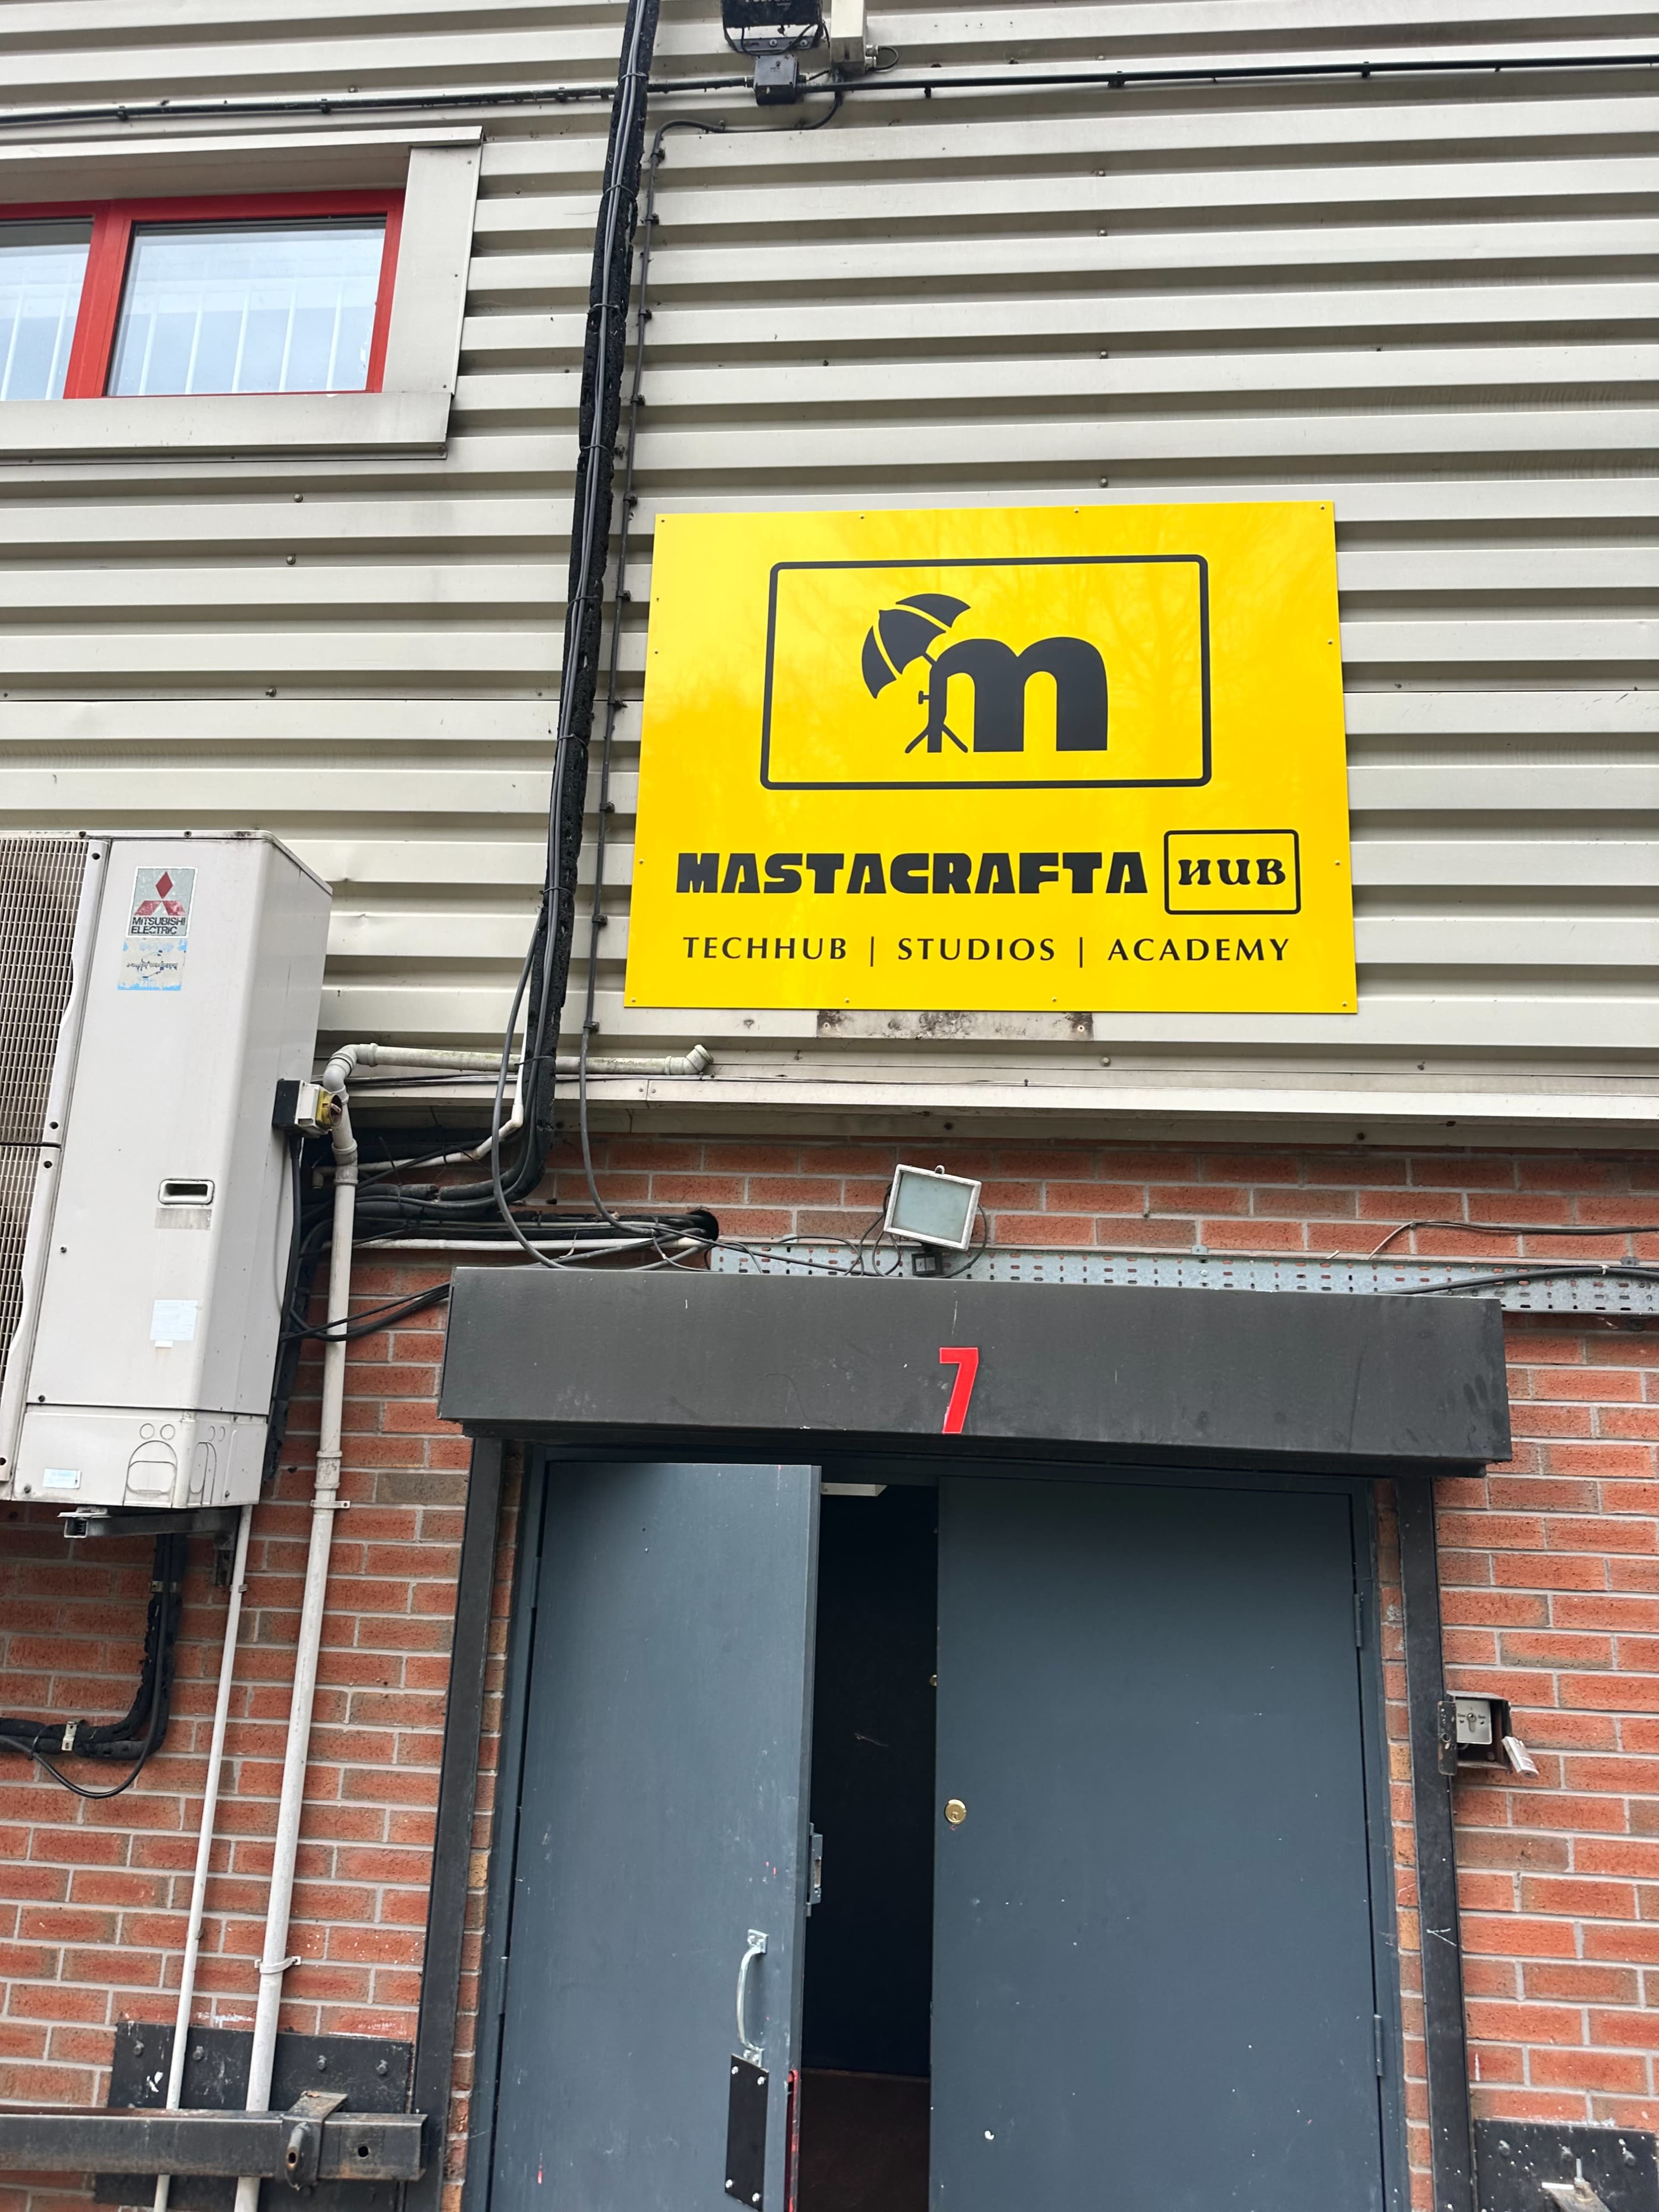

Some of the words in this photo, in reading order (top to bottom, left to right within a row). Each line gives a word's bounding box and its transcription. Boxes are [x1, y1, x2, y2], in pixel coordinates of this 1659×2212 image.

[676, 852, 1148, 894] MASTACRAFTA
[1178, 858, 1286, 885] HUB
[131, 926, 177, 934] ELECTRIC
[132, 917, 186, 925] MITSUBISHI
[683, 937, 847, 960] TECHHUB
[898, 938, 1055, 961] STUDIOS
[1107, 938, 1289, 961] ACADEMY
[939, 1346, 979, 1434] 7
